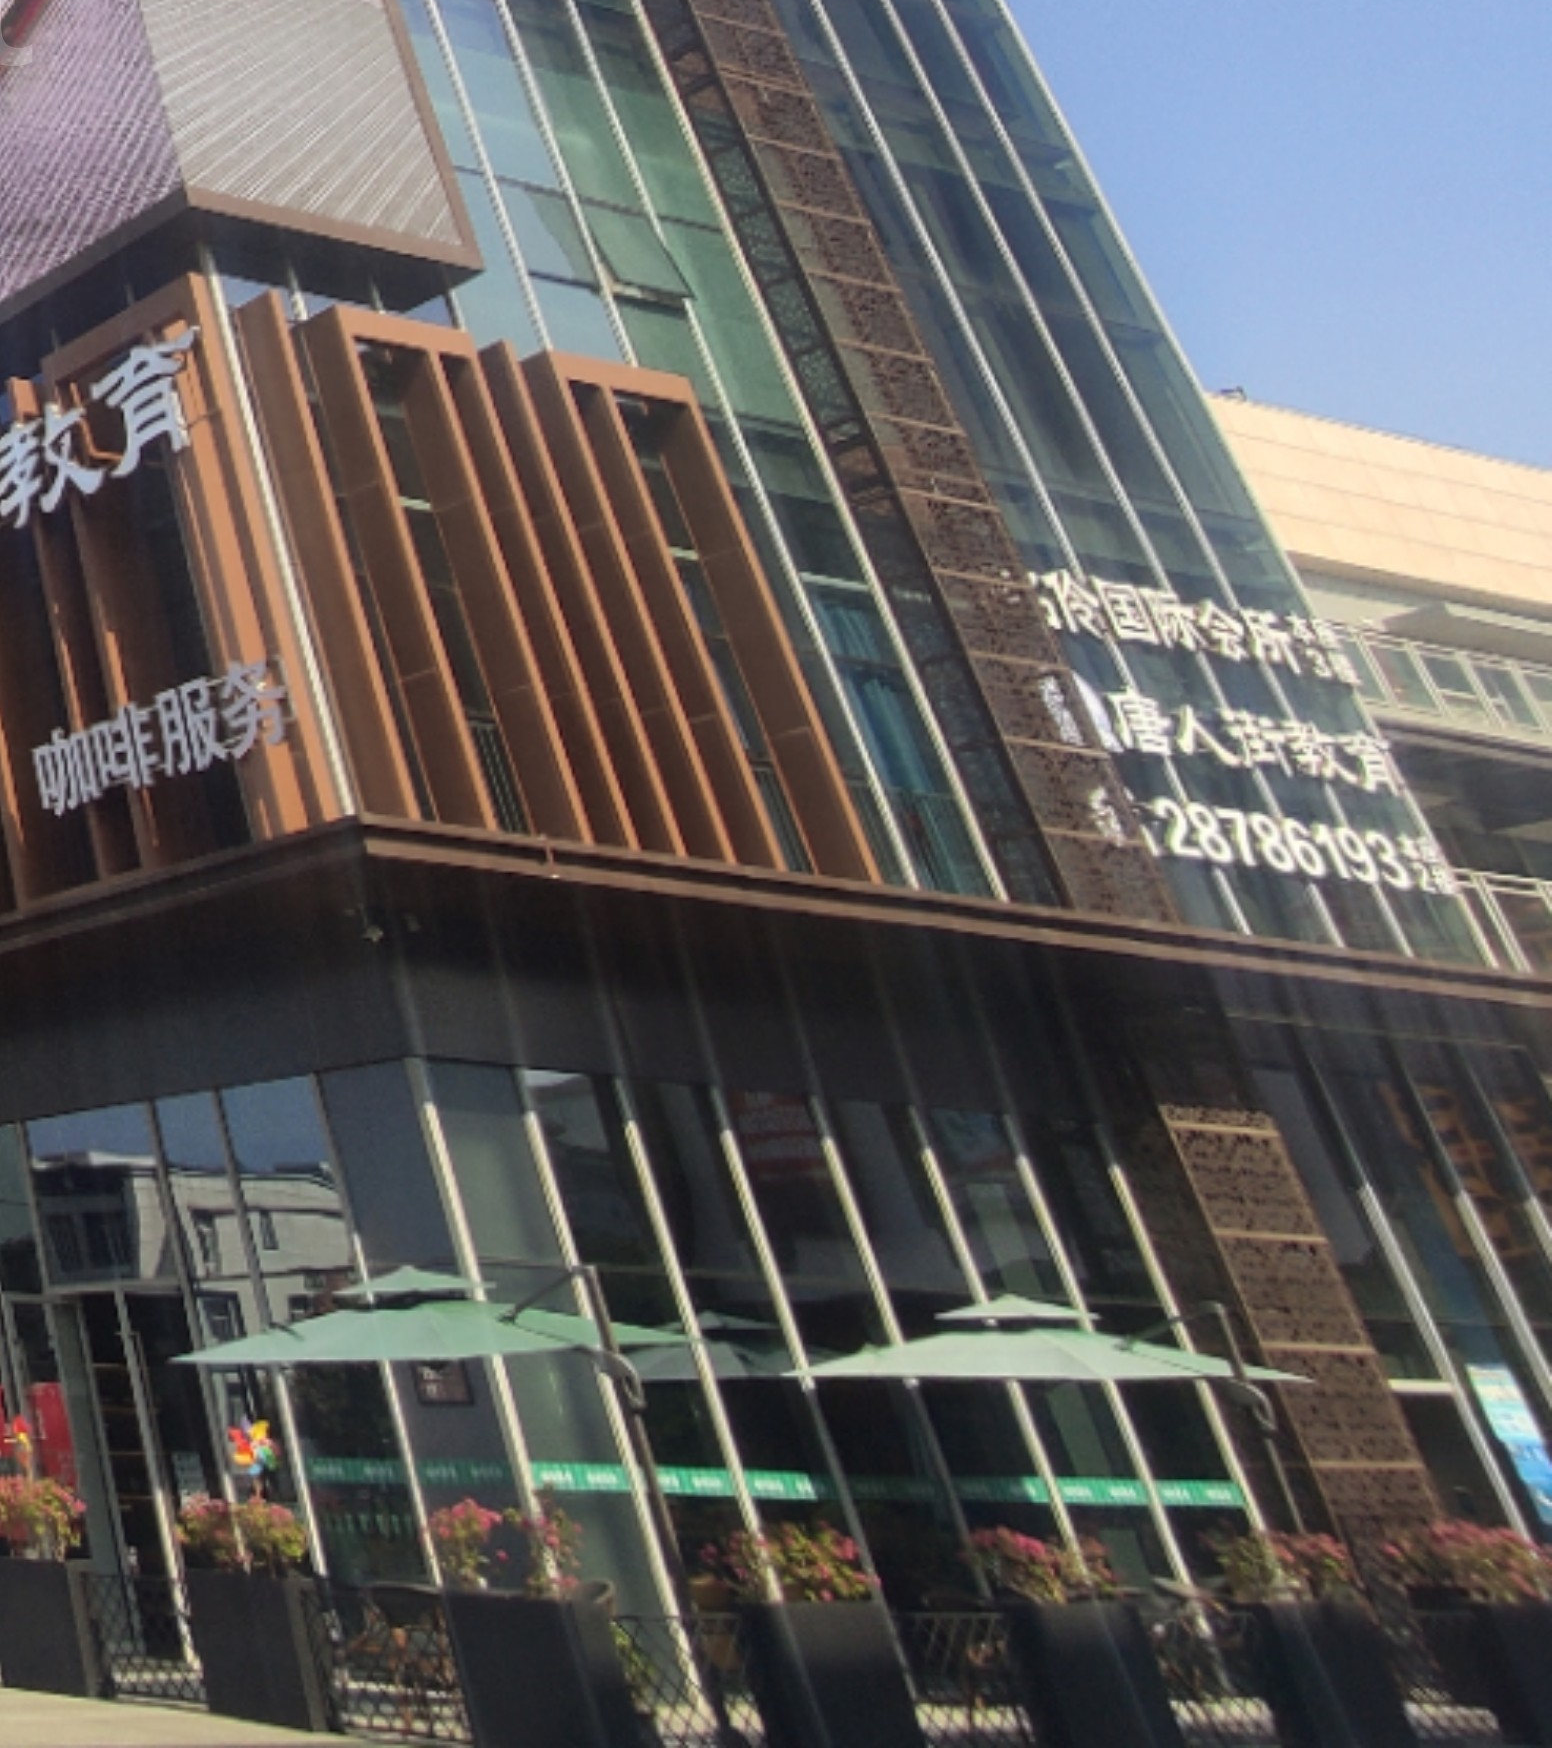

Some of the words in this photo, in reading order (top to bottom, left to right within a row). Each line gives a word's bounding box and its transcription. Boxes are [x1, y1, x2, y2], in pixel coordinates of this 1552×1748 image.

[32, 655, 294, 817] 咖啡服务
[1104, 684, 1408, 798] 唐人街教育
[1149, 795, 1411, 892] 28786193
